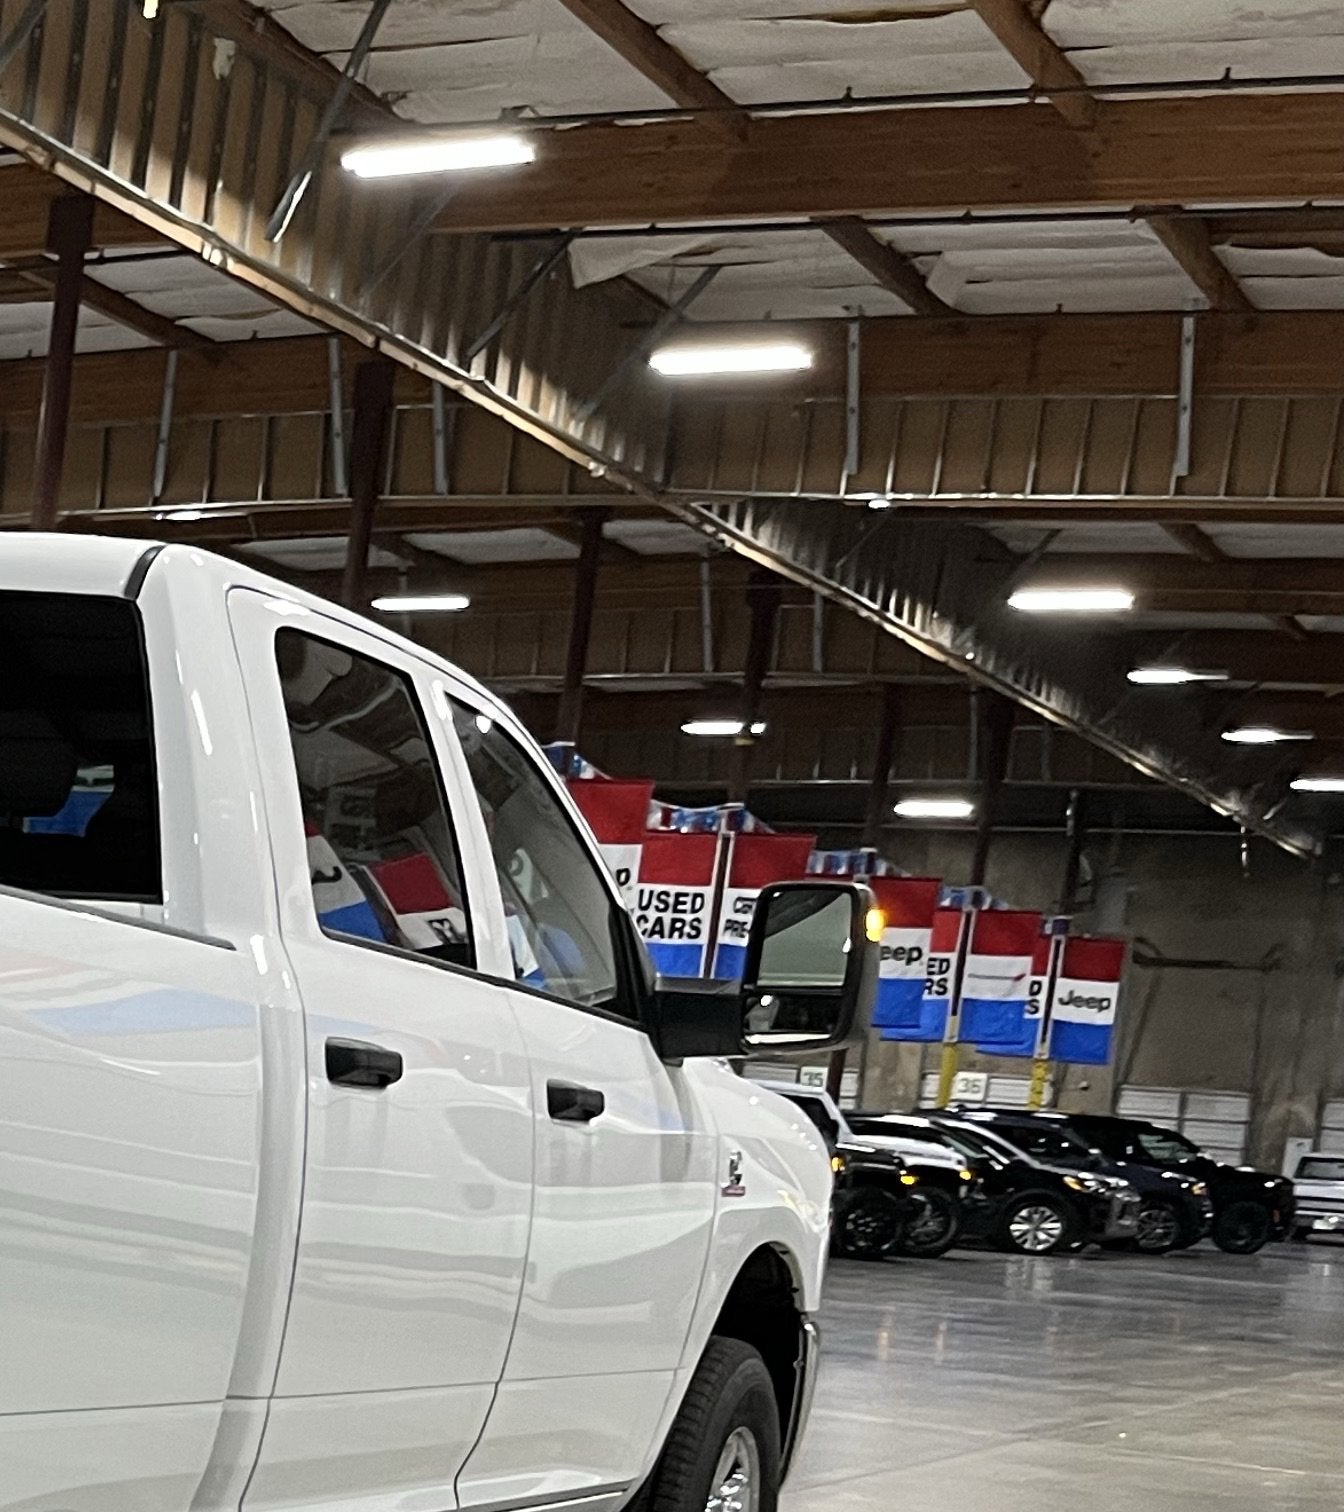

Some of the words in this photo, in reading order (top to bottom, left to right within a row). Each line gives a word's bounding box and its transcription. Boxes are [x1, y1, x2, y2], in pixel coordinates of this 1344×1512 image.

[637, 889, 705, 914] USED
[636, 914, 703, 939] CARS
[879, 945, 923, 967] eep
[926, 957, 951, 976] ED
[1057, 989, 1112, 1013] Jeep
